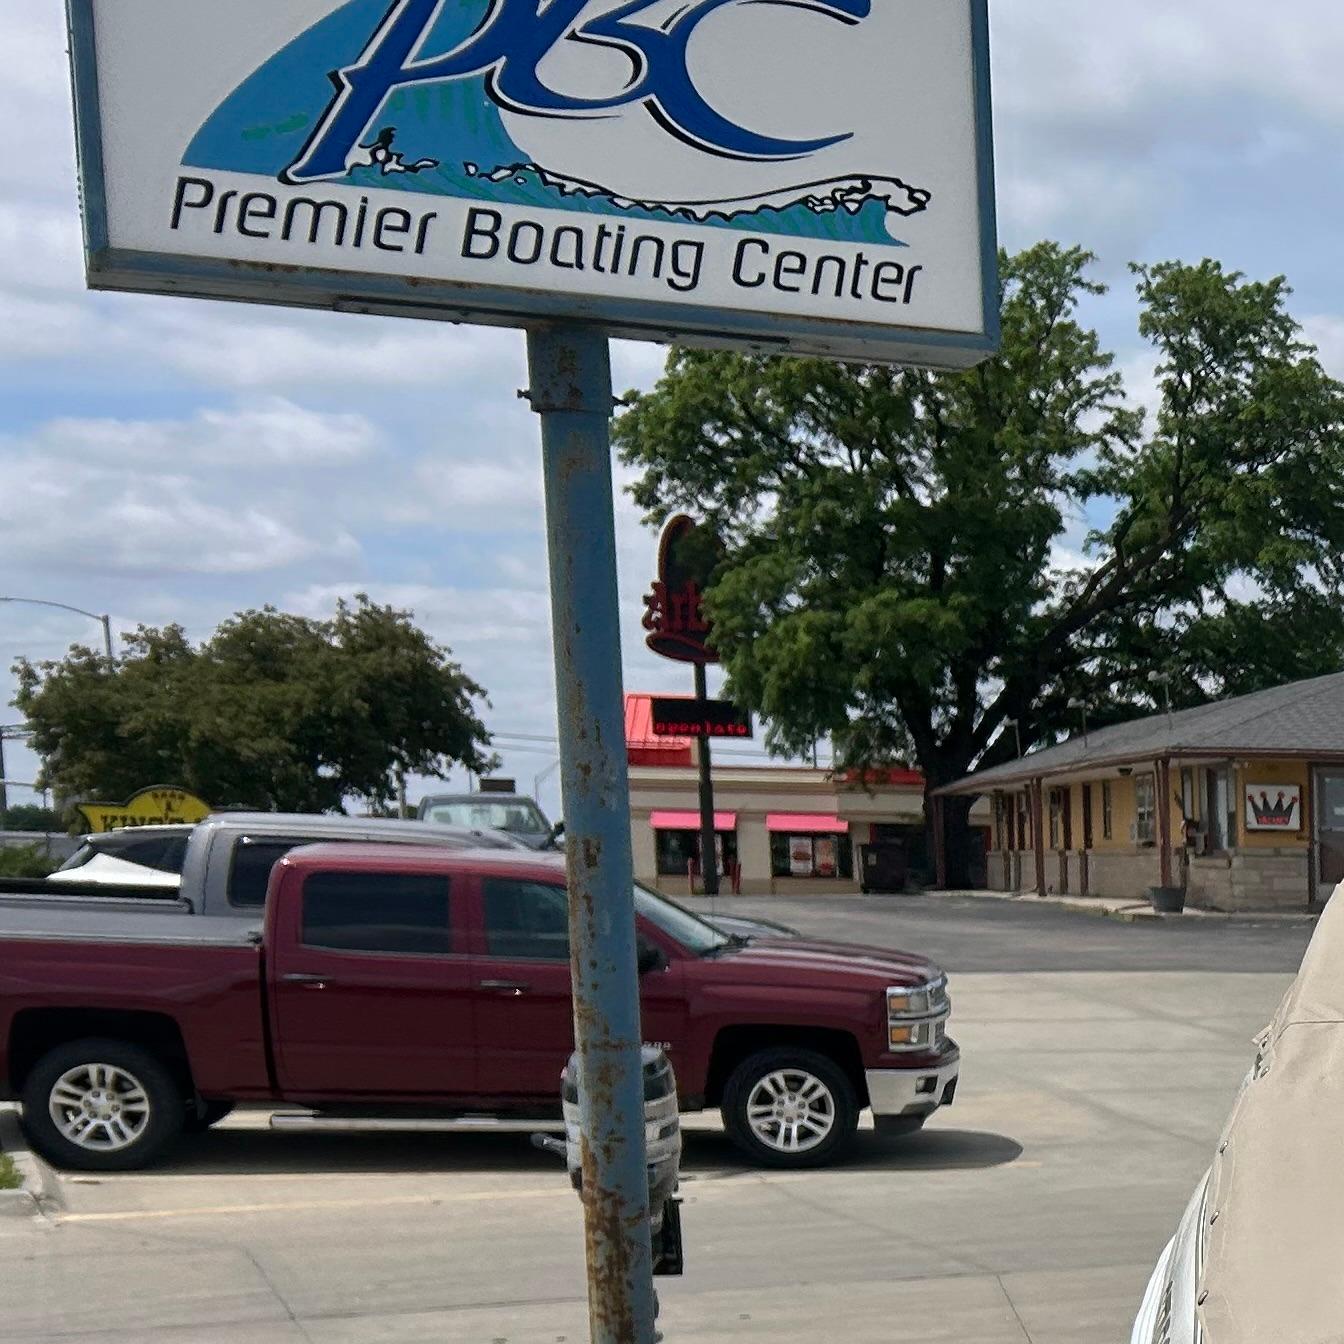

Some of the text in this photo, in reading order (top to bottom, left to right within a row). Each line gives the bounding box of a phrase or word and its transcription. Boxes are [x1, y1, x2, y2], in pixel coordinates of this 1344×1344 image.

[171, 176, 923, 305] Premier Boating Center
